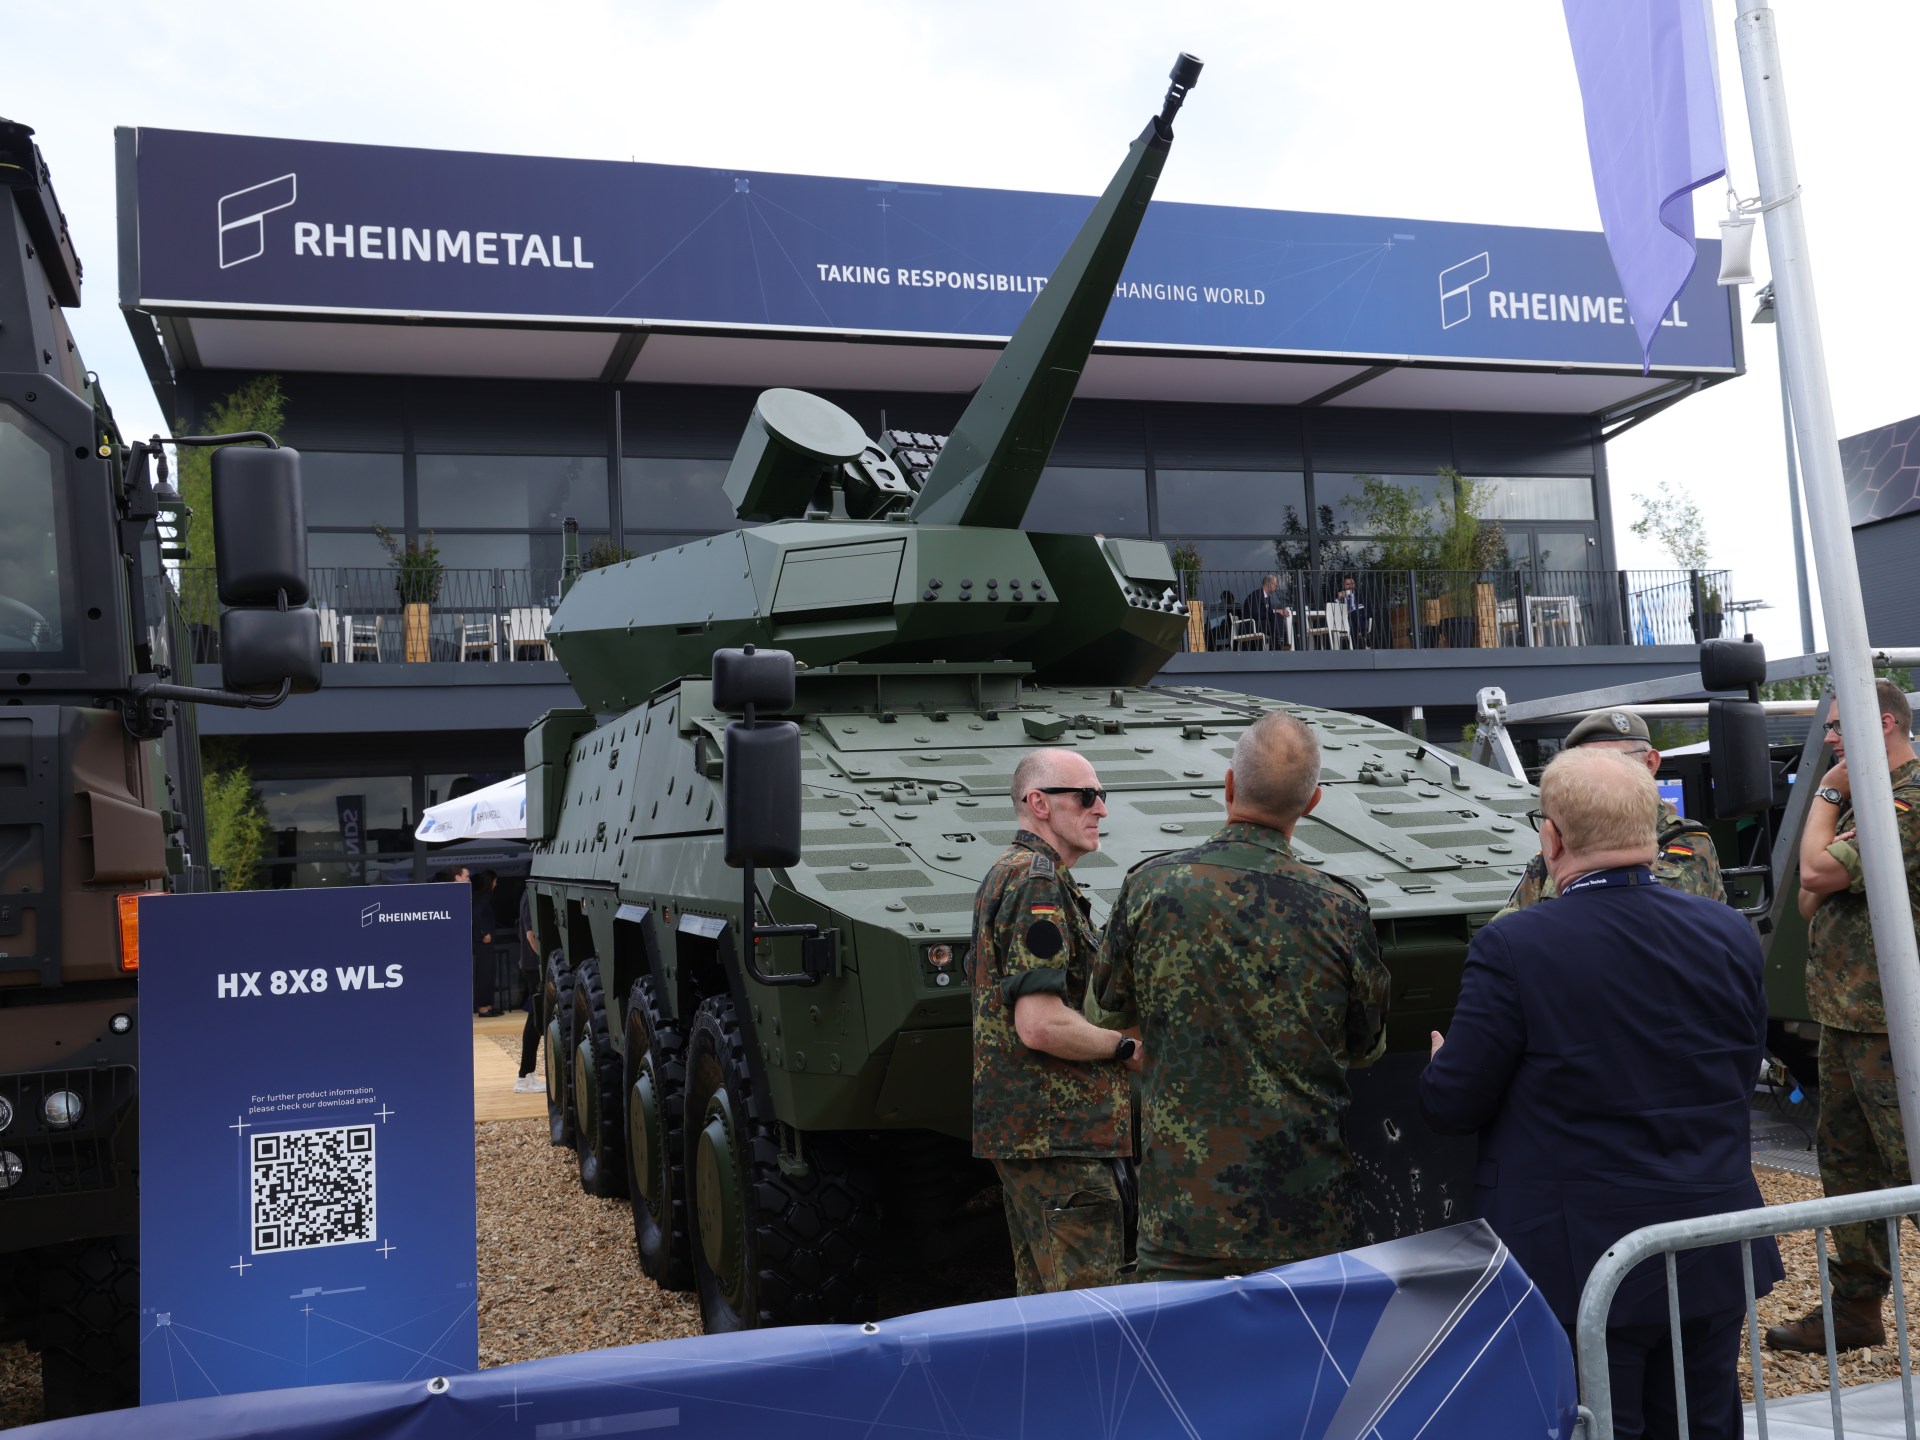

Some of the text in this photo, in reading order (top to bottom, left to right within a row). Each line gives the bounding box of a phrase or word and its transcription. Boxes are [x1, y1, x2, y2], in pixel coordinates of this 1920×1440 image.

[294, 221, 594, 269] RHEINMETALL
[816, 263, 891, 285] TAKING
[1112, 281, 1198, 303] HANGING
[1203, 286, 1266, 306] WORLD
[378, 910, 452, 922] RHEINMETALL
[217, 963, 404, 999] HX 8X8 WLS
[248, 1105, 275, 1115] please
[276, 1102, 301, 1111] check
[317, 1098, 355, 1108] download
[356, 1095, 377, 1104] area!
[251, 1086, 374, 1103] For further product information
